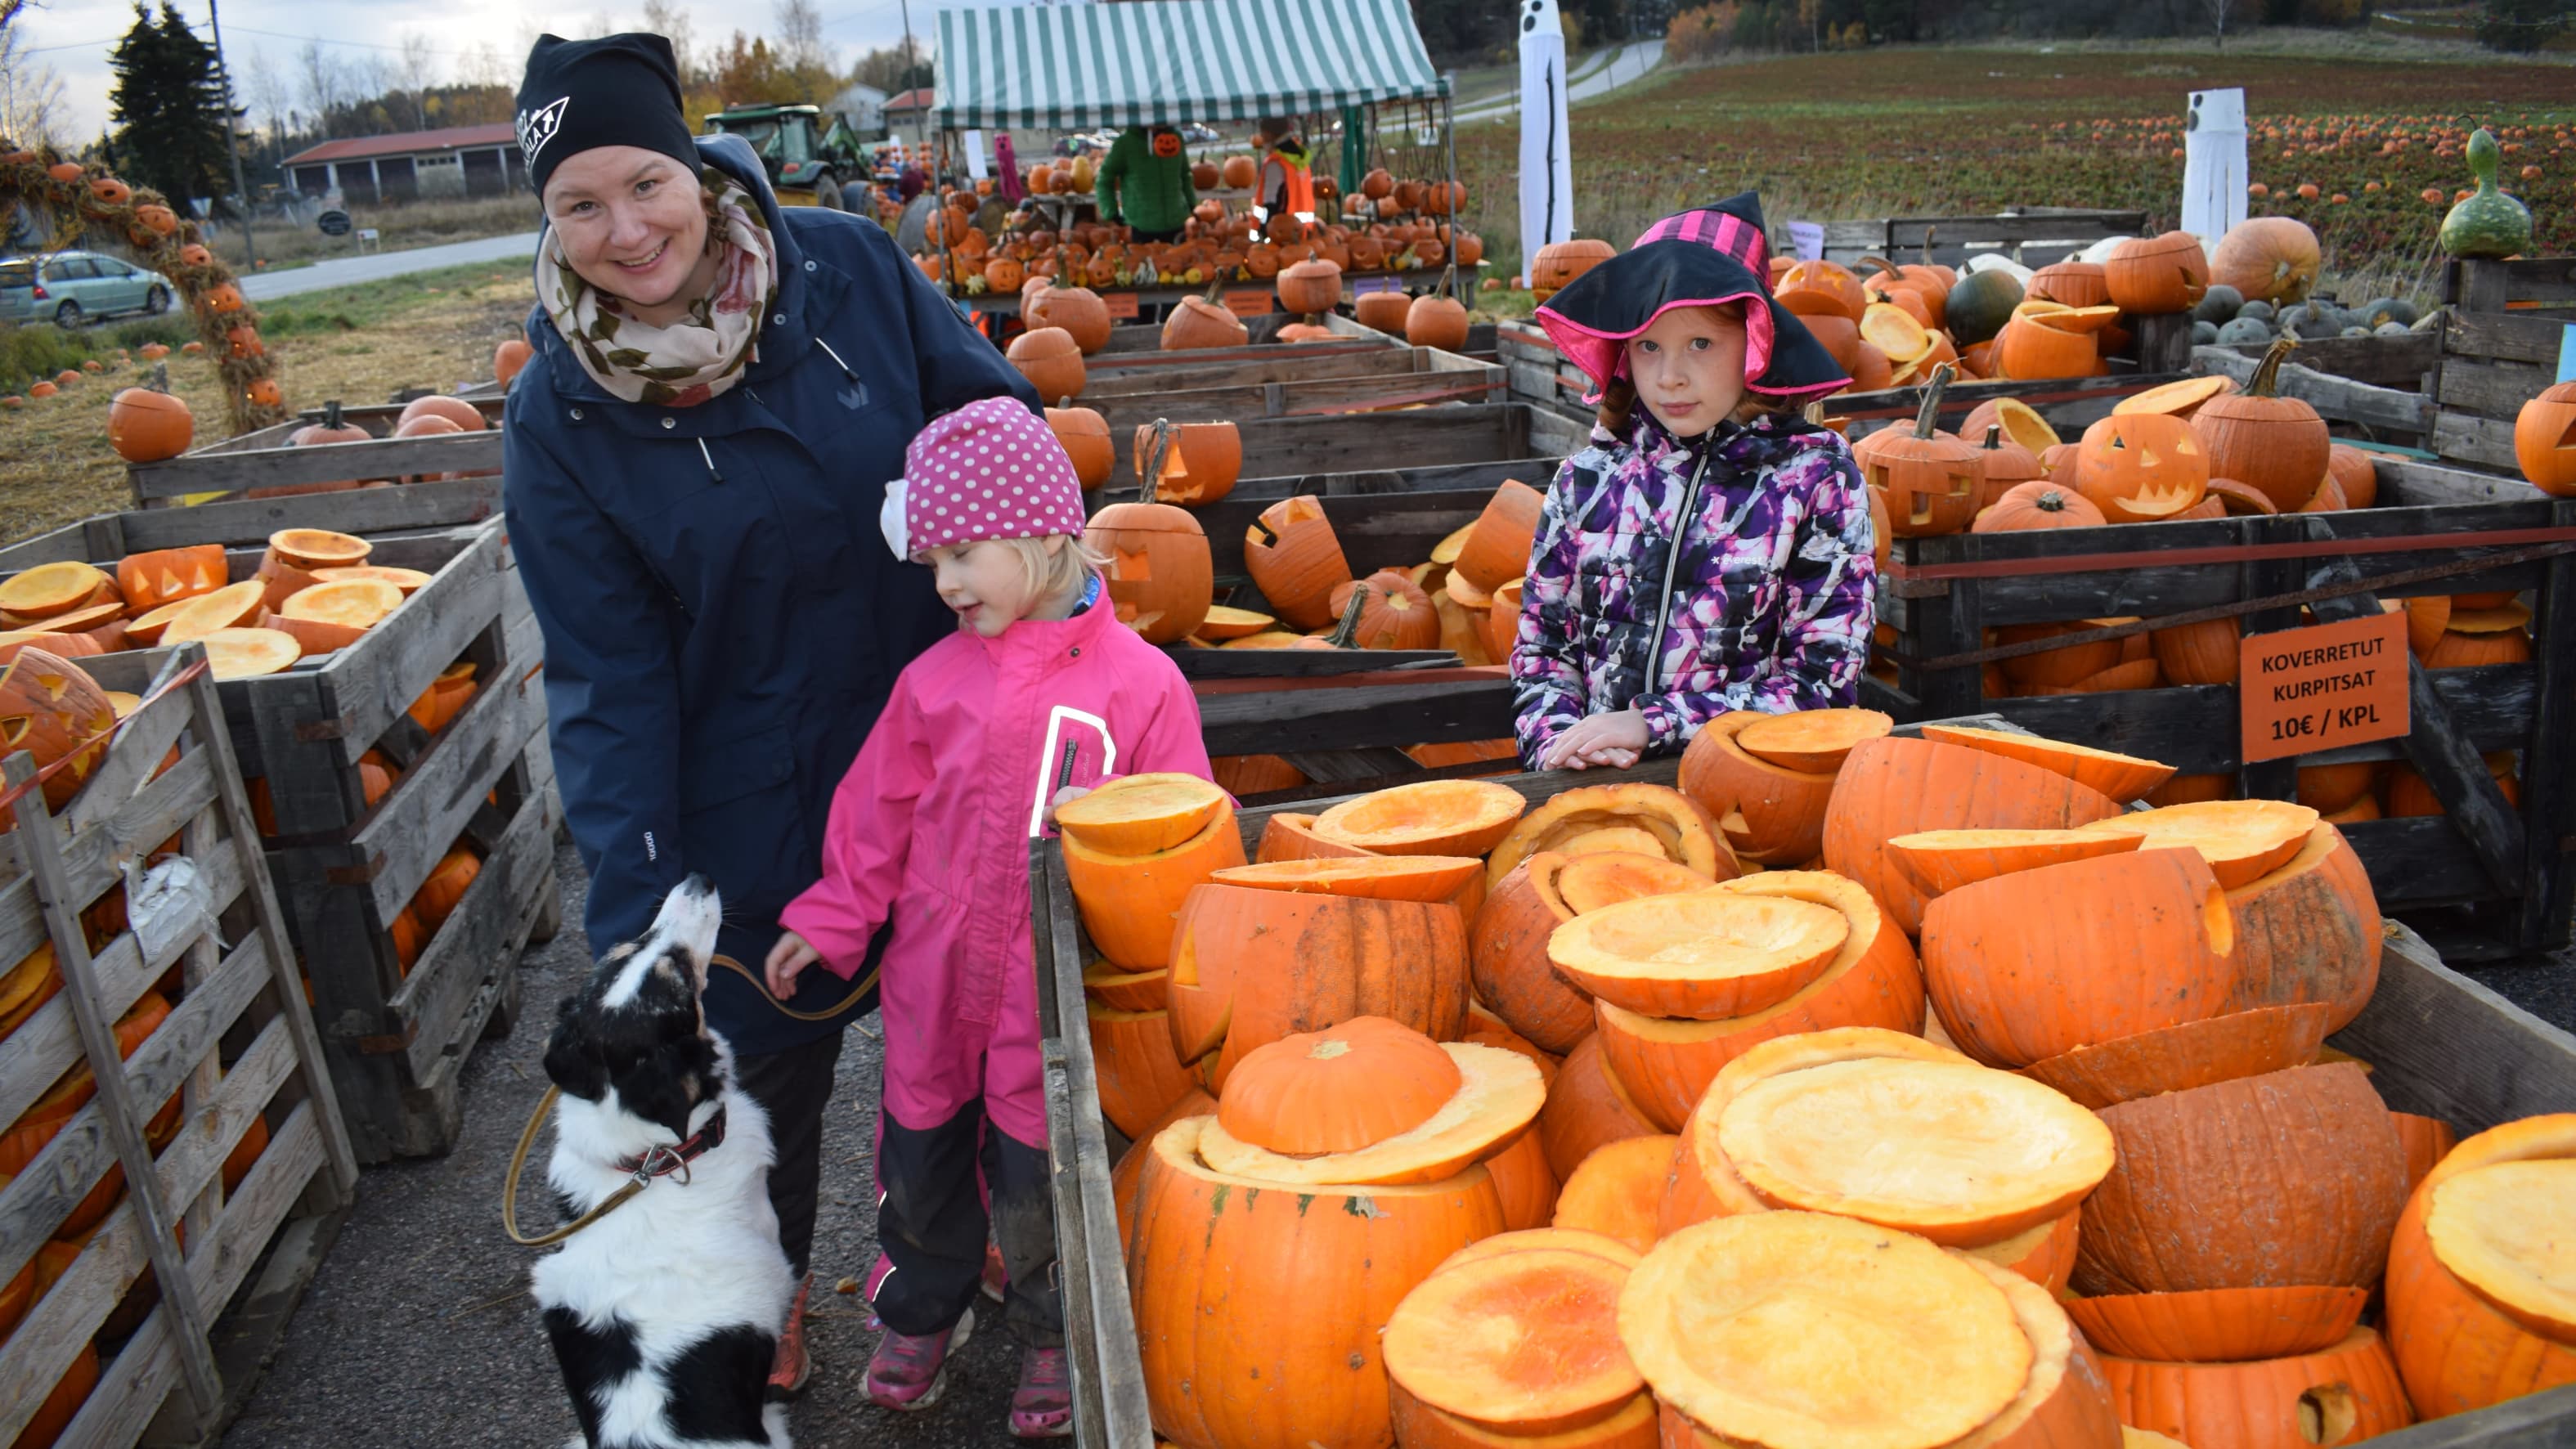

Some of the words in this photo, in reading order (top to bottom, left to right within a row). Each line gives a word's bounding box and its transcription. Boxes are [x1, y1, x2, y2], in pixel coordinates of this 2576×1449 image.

[1723, 555, 1764, 565] everest
[2262, 637, 2385, 674] KOVERRETUT
[2273, 670, 2376, 702] KURPITSAT
[2272, 715, 2314, 741] 10€
[2319, 708, 2331, 737] /
[2339, 704, 2381, 729] KPL
